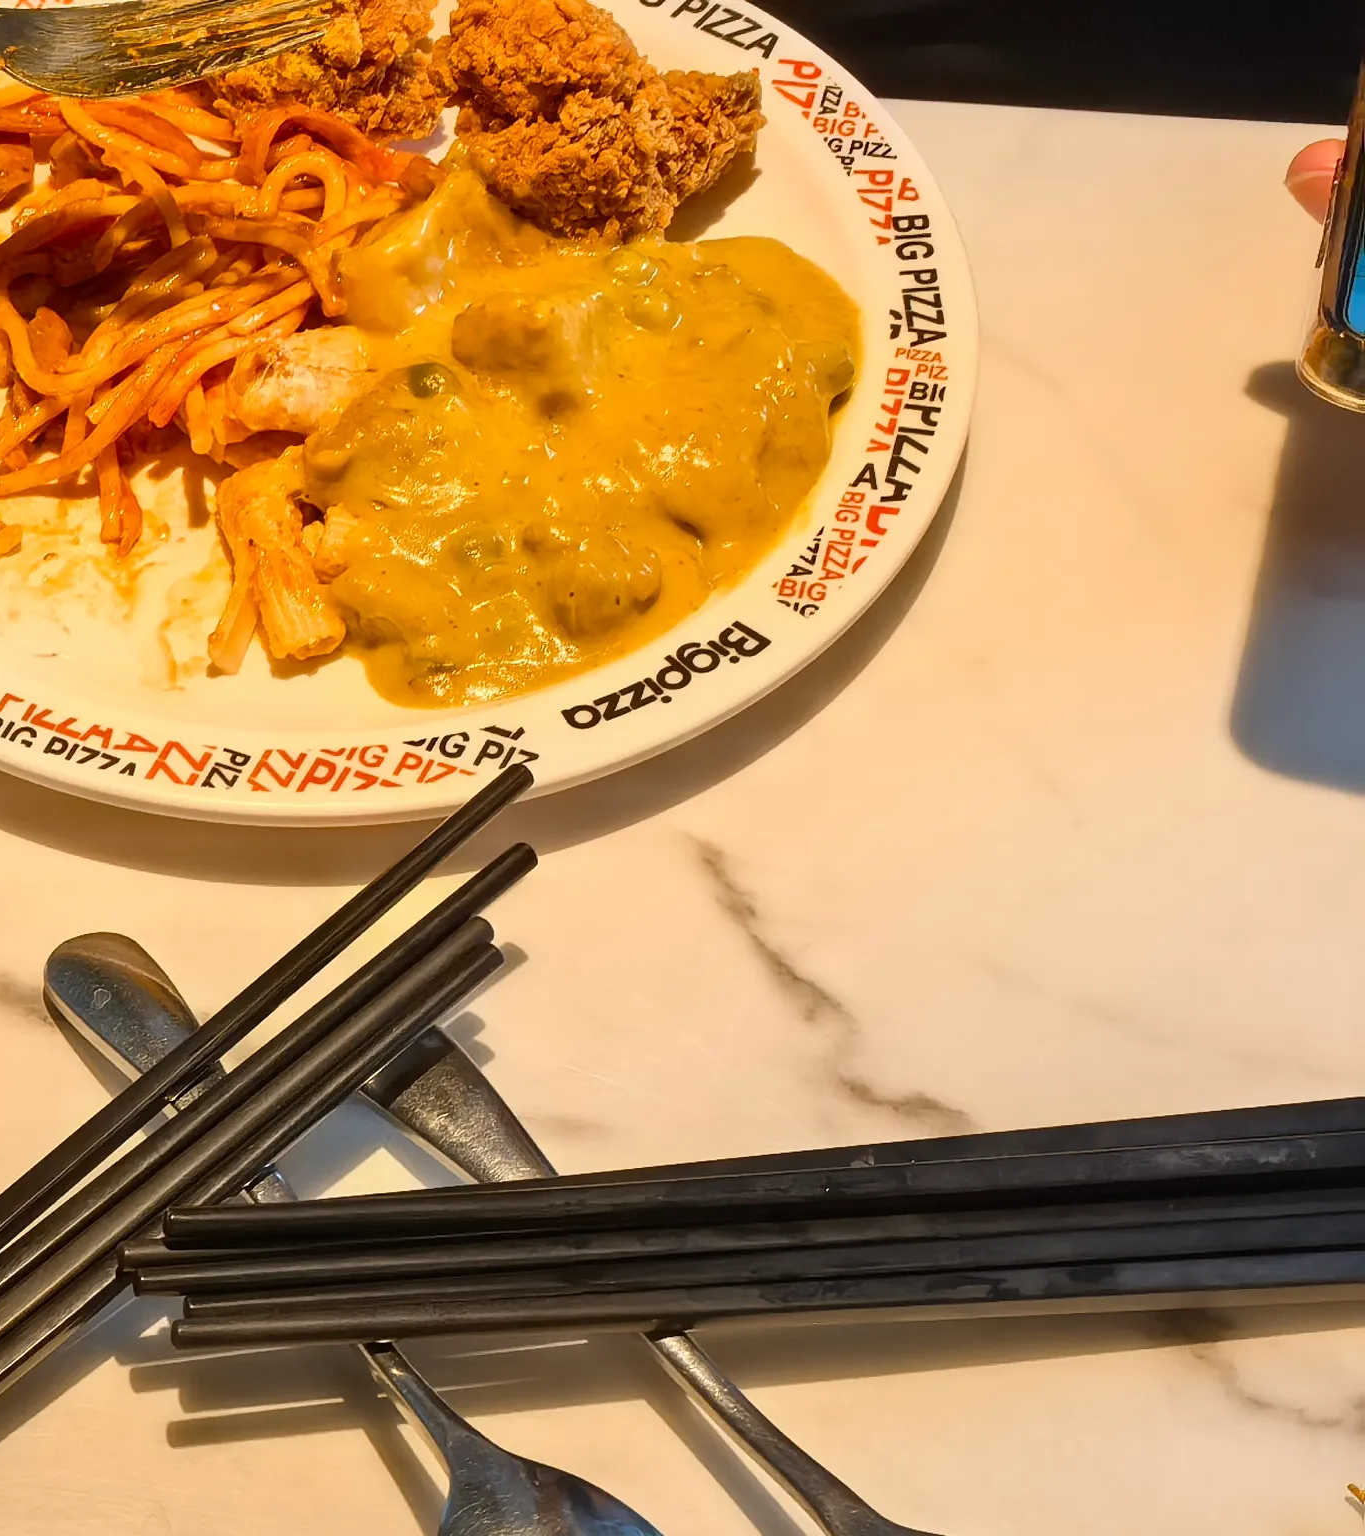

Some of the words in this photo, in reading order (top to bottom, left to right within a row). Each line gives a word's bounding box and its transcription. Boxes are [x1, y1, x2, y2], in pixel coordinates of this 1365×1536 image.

[670, 0, 779, 60] PIZZA
[892, 214, 935, 262] BIG
[898, 268, 947, 348] PIZZA
[895, 346, 943, 363] PIZZA
[835, 490, 867, 524] BIG
[818, 528, 857, 582] PIZZA
[777, 577, 827, 602] BIG
